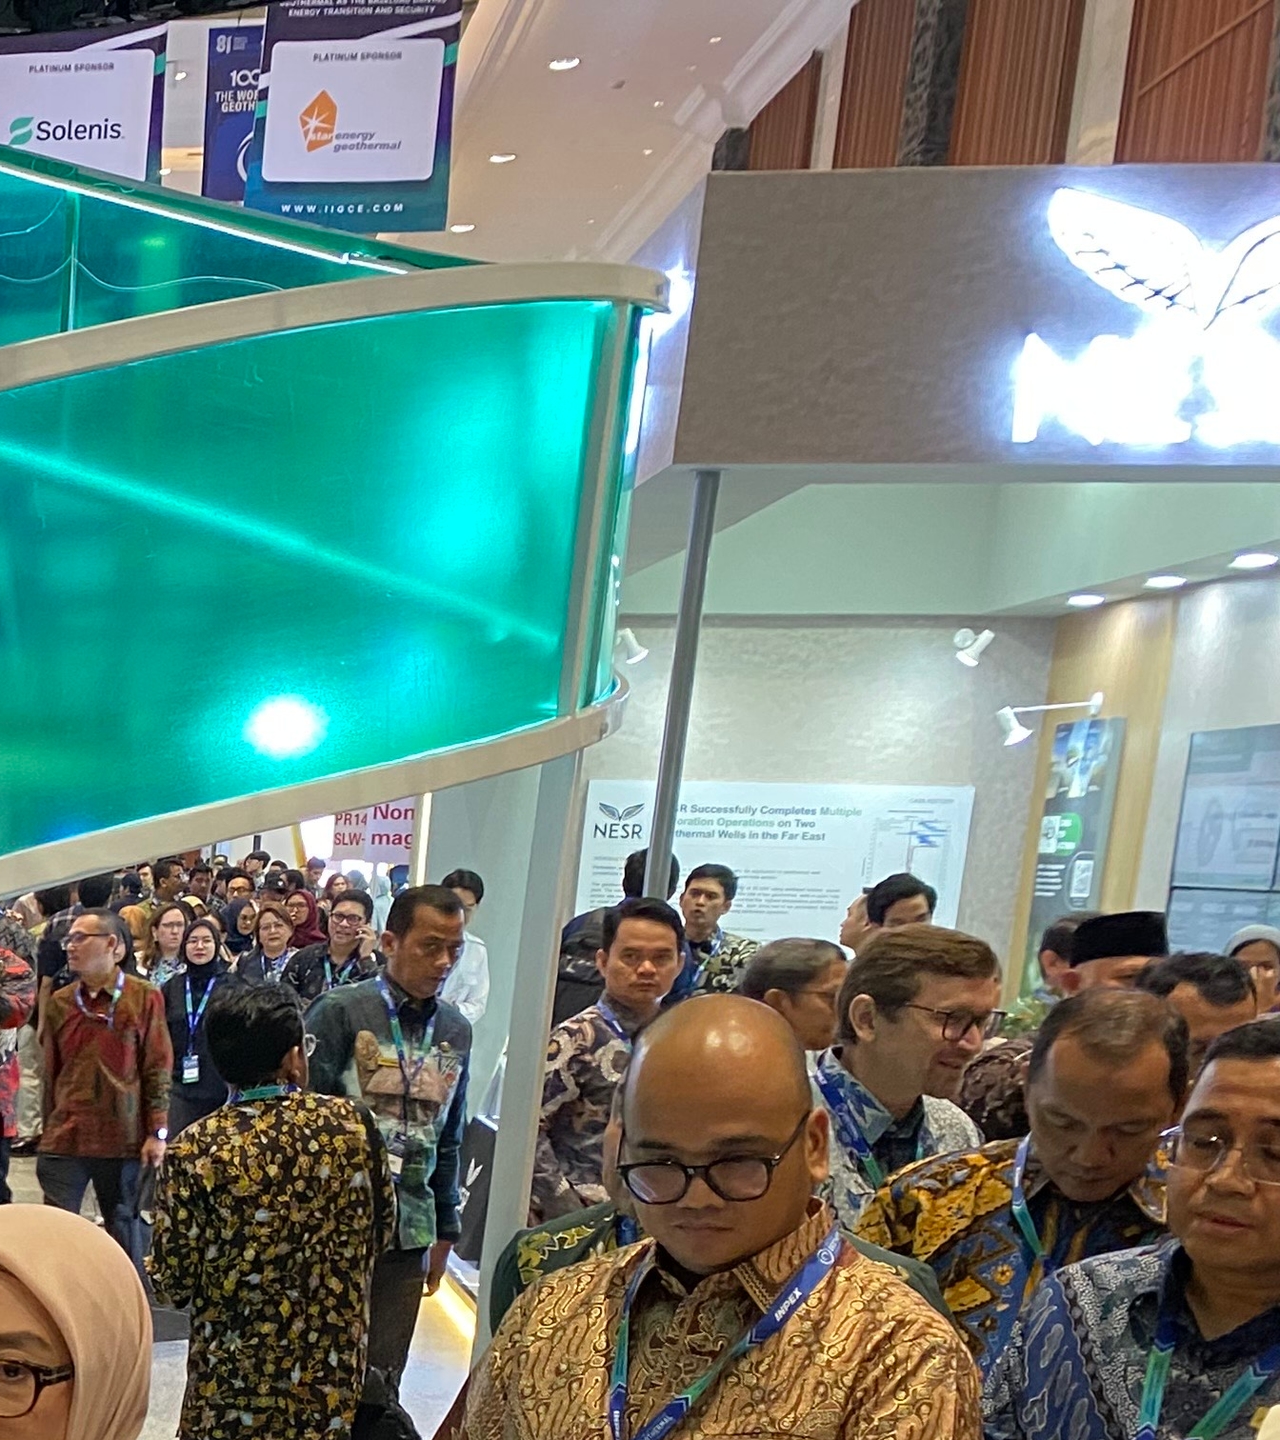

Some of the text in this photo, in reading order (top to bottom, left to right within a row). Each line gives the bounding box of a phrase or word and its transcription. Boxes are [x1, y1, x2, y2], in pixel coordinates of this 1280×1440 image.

[288, 5, 436, 17] ENERGY TRANSITION AND SECURITY
[313, 51, 403, 63] PLATINUM SPONSOR
[29, 62, 115, 74] PLATINUM SPONSOR
[215, 91, 235, 103] THE
[36, 118, 123, 142] Solenis
[334, 130, 376, 142] energy
[333, 141, 402, 153] geothermal
[690, 804, 758, 816] Successfully
[759, 805, 818, 817] Completes
[819, 806, 862, 818] Multiple
[335, 812, 368, 826] PR14
[716, 817, 775, 828] Operations
[778, 819, 791, 828] on
[795, 818, 816, 828] Two
[593, 823, 643, 839] NESR
[718, 829, 746, 839] Wells
[749, 830, 759, 839] in
[761, 830, 778, 840] the
[781, 830, 800, 841] Far
[801, 830, 826, 842] East
[334, 832, 366, 846] SLW-
[773, 1286, 803, 1322] INPEX
